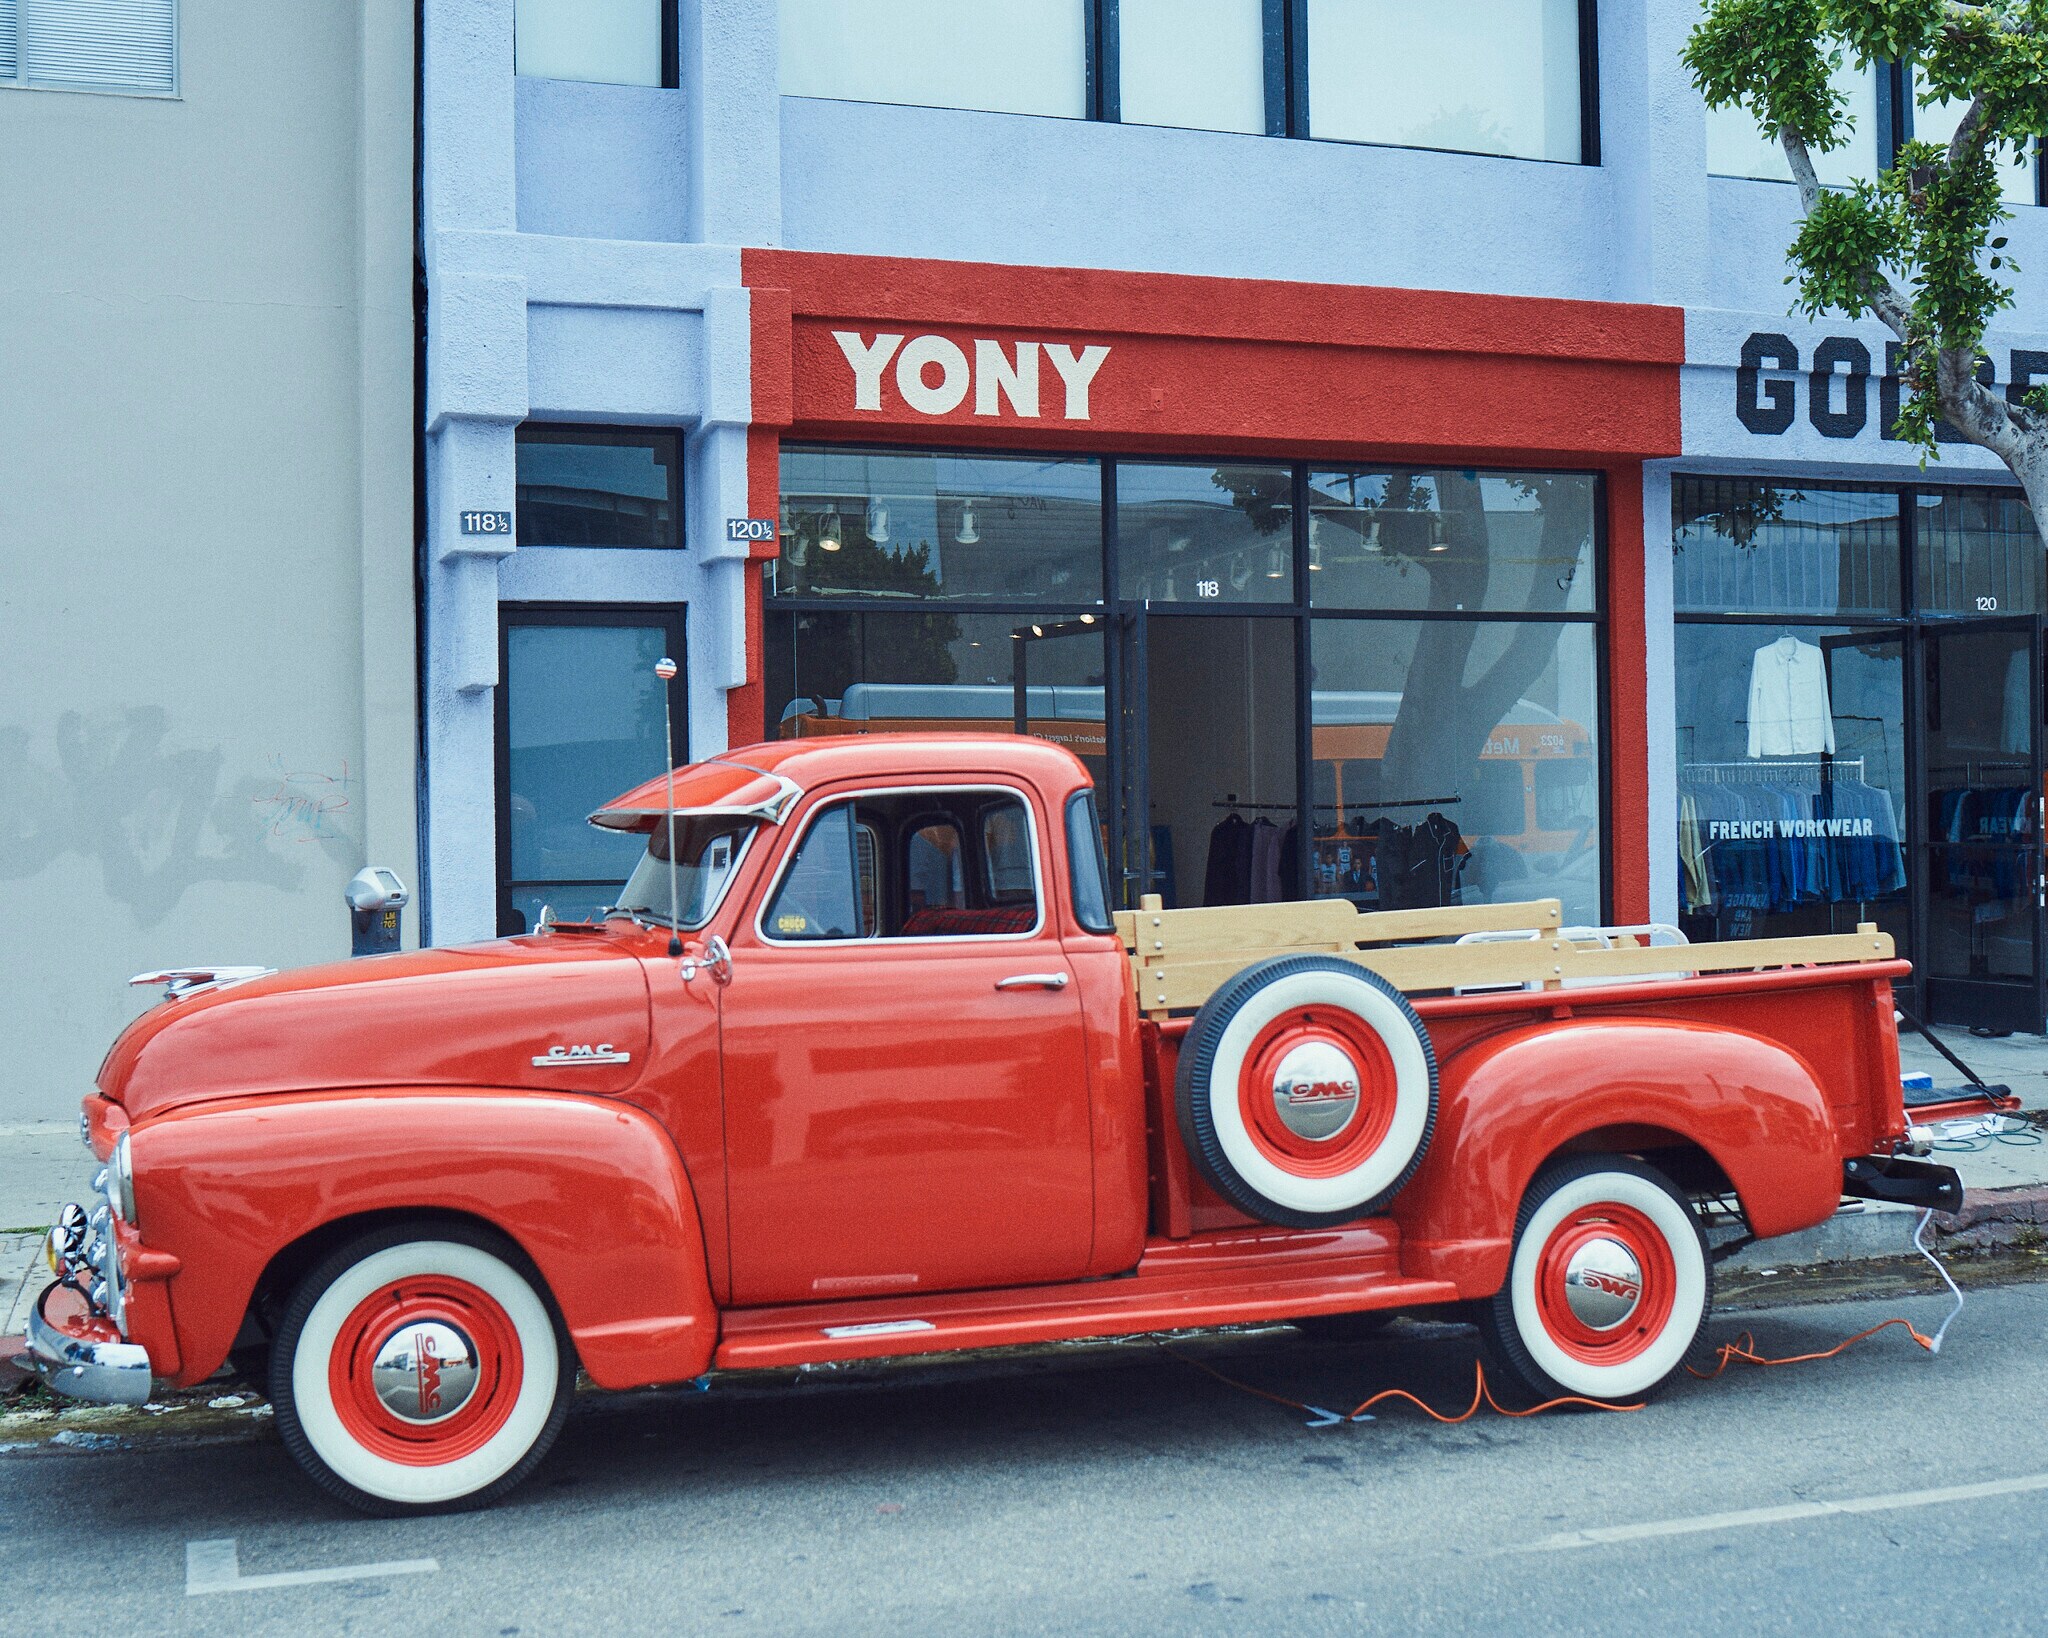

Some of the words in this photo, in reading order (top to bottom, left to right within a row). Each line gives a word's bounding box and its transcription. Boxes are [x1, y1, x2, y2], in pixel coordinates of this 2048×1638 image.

[831, 331, 1112, 420] YONY
[1196, 580, 1219, 597] 118
[1975, 596, 1997, 611] 120
[1709, 820, 1774, 840] FRENCH
[1779, 818, 1873, 838] WORKWEAR
[548, 1043, 614, 1057] GMC
[1292, 1080, 1354, 1097] GMC
[1583, 1276, 1638, 1301] GMC
[422, 1335, 442, 1410] GMC
